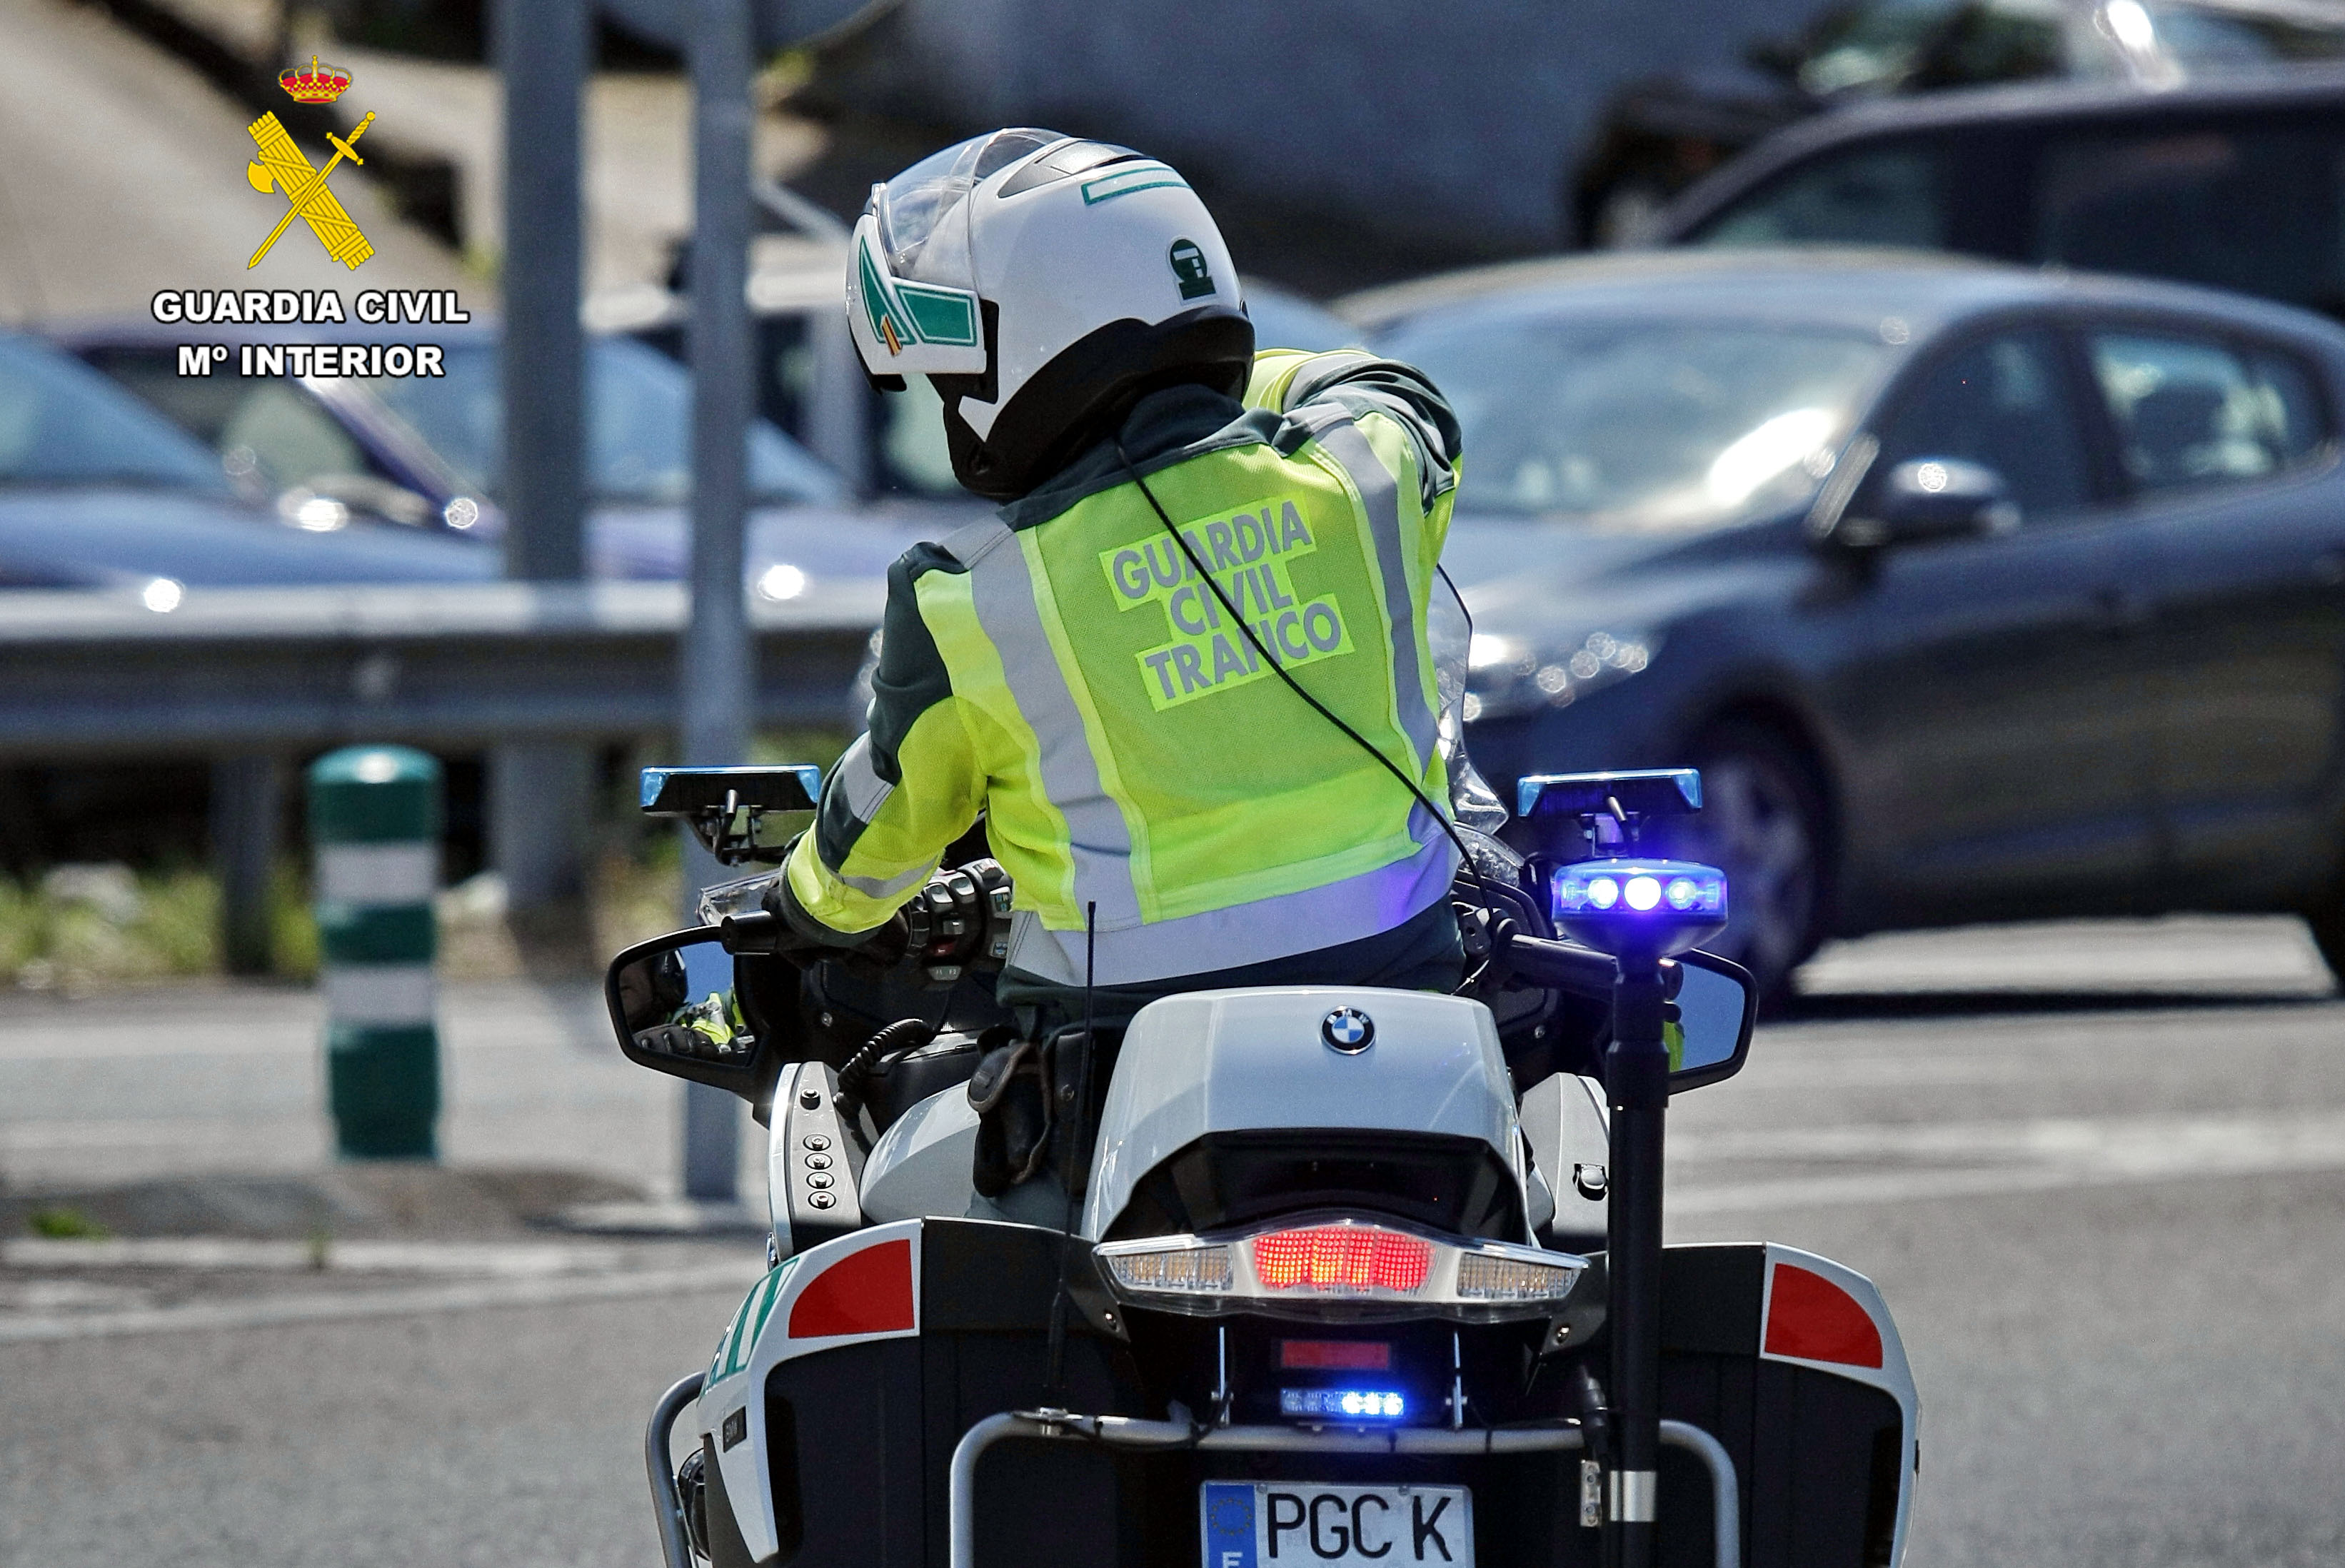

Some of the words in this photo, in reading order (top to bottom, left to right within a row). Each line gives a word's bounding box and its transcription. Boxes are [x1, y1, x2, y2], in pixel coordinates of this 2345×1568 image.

[1113, 500, 1312, 599] GUARDIA
[1170, 563, 1293, 635] CIVIL
[1145, 602, 1342, 700] TRAFICO
[1267, 1493, 1392, 1559] PGC
[1411, 1495, 1453, 1562] K
